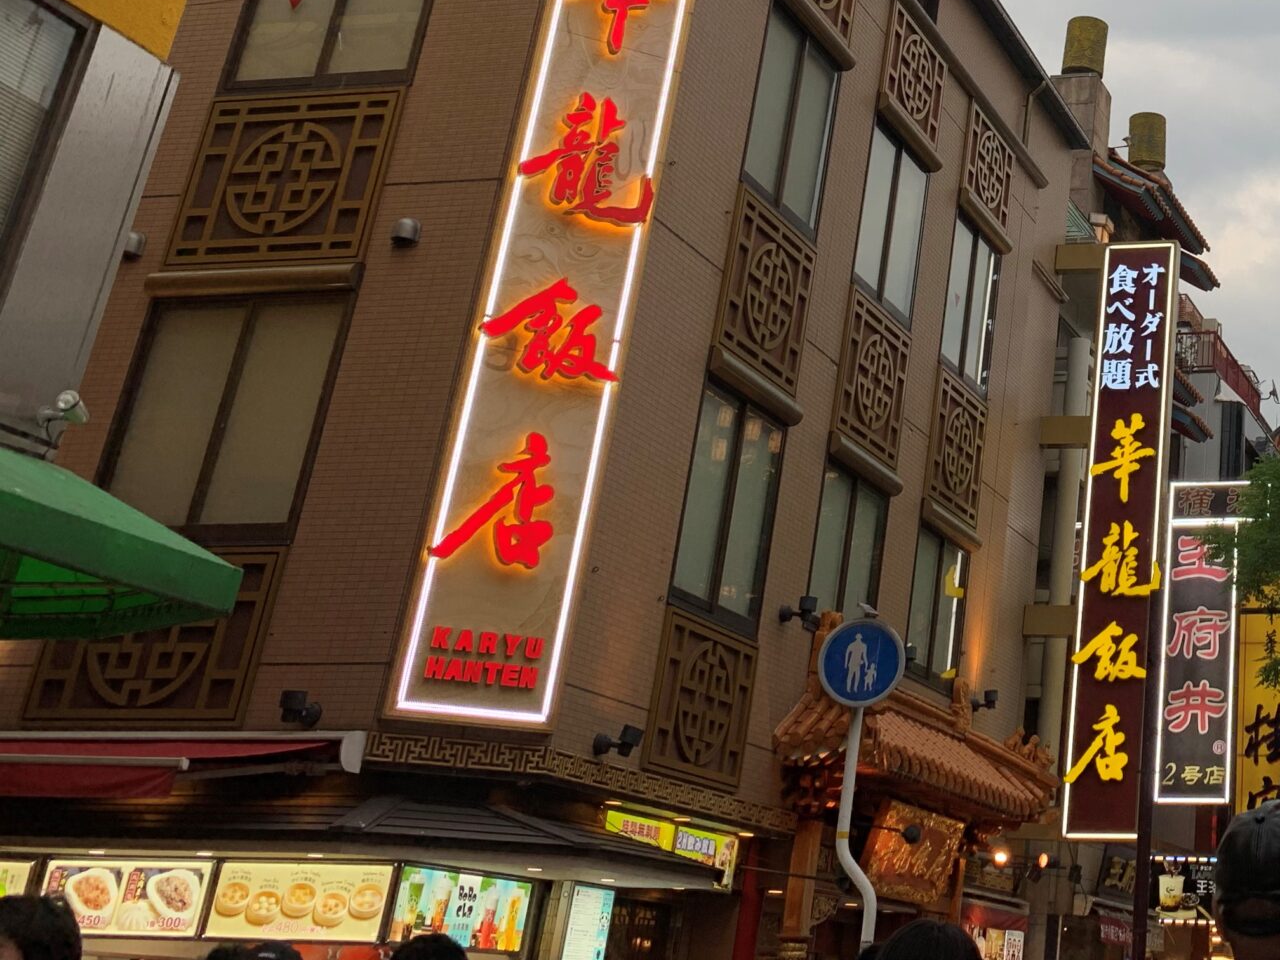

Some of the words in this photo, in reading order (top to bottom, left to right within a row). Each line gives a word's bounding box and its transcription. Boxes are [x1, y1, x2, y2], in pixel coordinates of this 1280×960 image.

[1100, 264, 1139, 390] 食べ放題
[1134, 263, 1166, 389] オーダー式
[431, 626, 545, 660] KARYU
[1064, 412, 1161, 783] 華龍飯店
[1164, 535, 1231, 734] 王府井
[425, 656, 538, 689] HANTEN
[1162, 762, 1225, 785] 2号店
